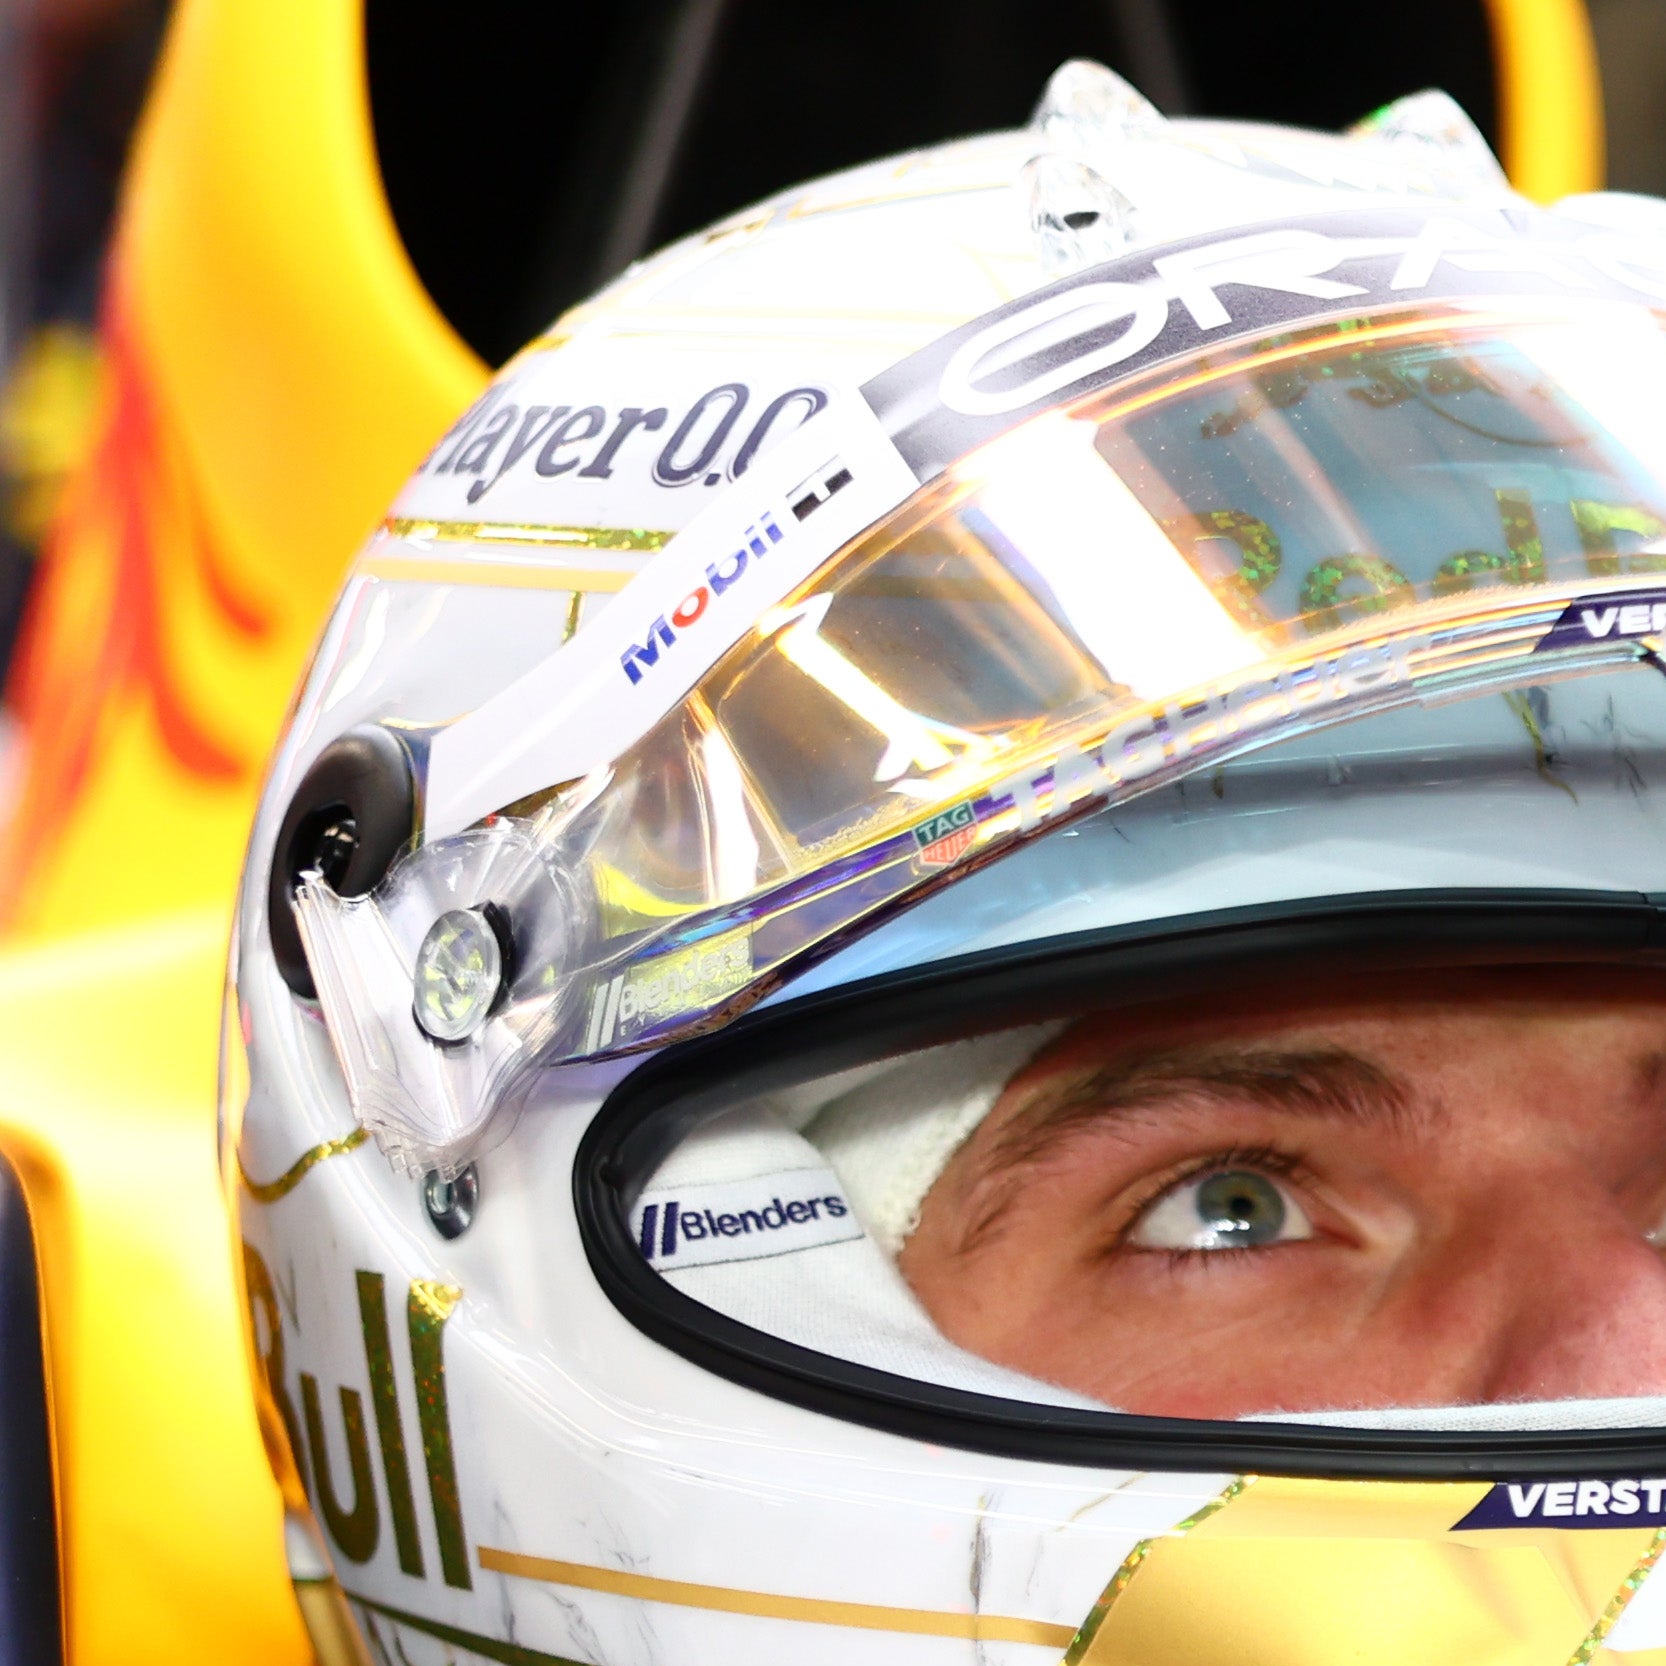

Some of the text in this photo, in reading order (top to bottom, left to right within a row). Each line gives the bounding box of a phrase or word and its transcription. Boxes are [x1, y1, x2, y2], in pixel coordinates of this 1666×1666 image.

[418, 379, 669, 506] layer
[619, 510, 784, 687] Mobil
[918, 804, 970, 841] TAG
[680, 1195, 848, 1242] Blenders
